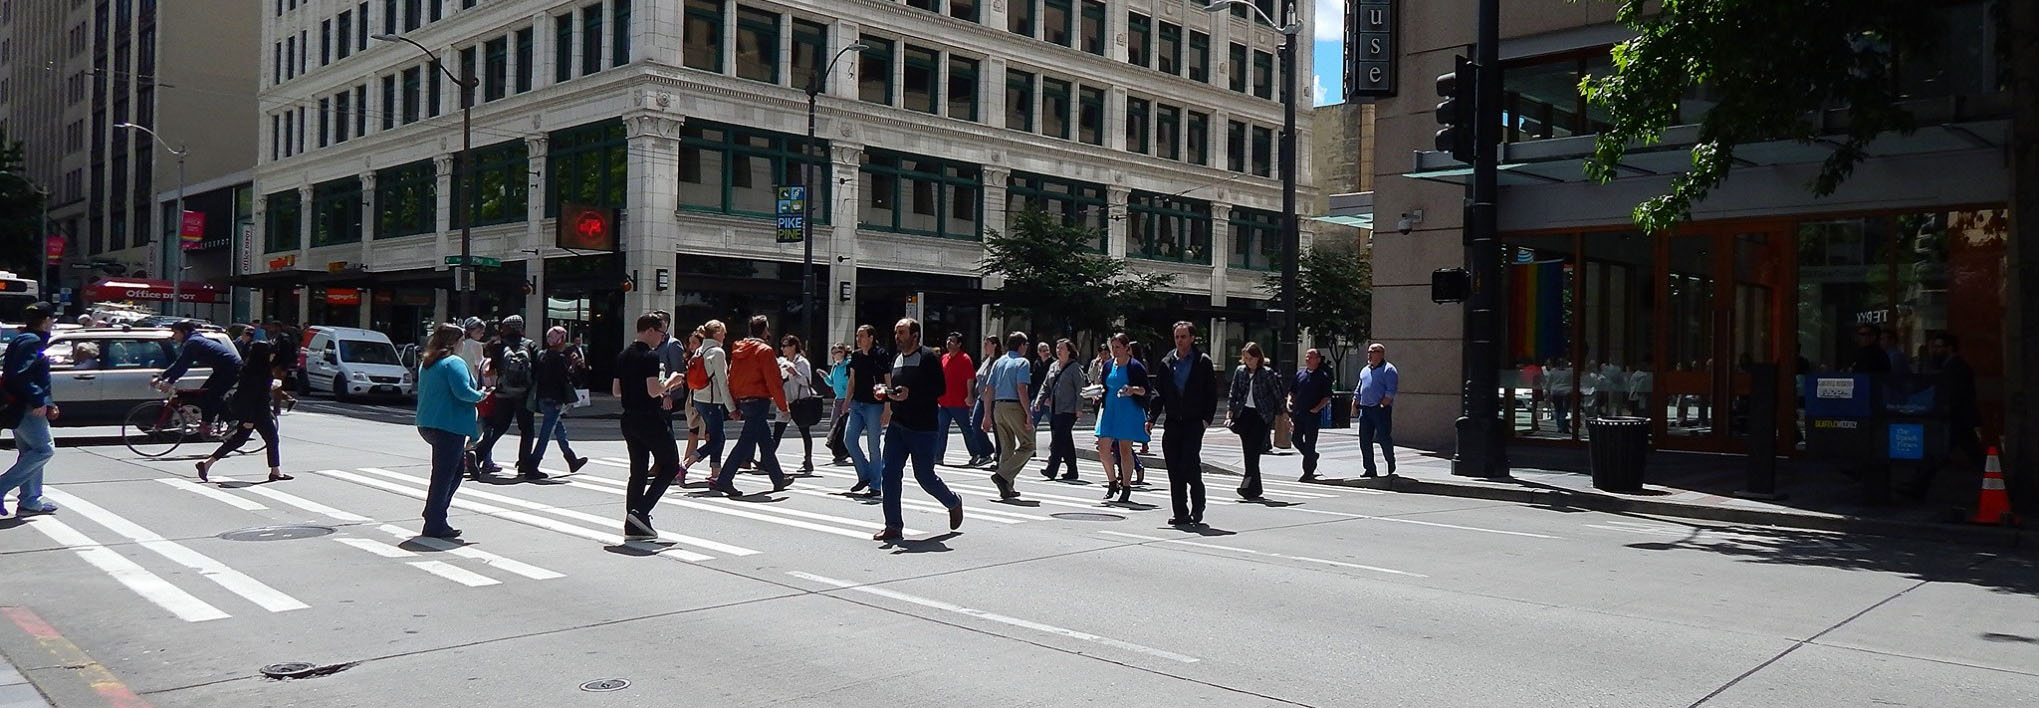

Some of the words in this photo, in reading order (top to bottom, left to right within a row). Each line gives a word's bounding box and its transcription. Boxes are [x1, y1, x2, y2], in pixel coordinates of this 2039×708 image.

[778, 217, 802, 228] PIKE
[778, 229, 802, 240] PINE
[126, 290, 161, 298] Office
